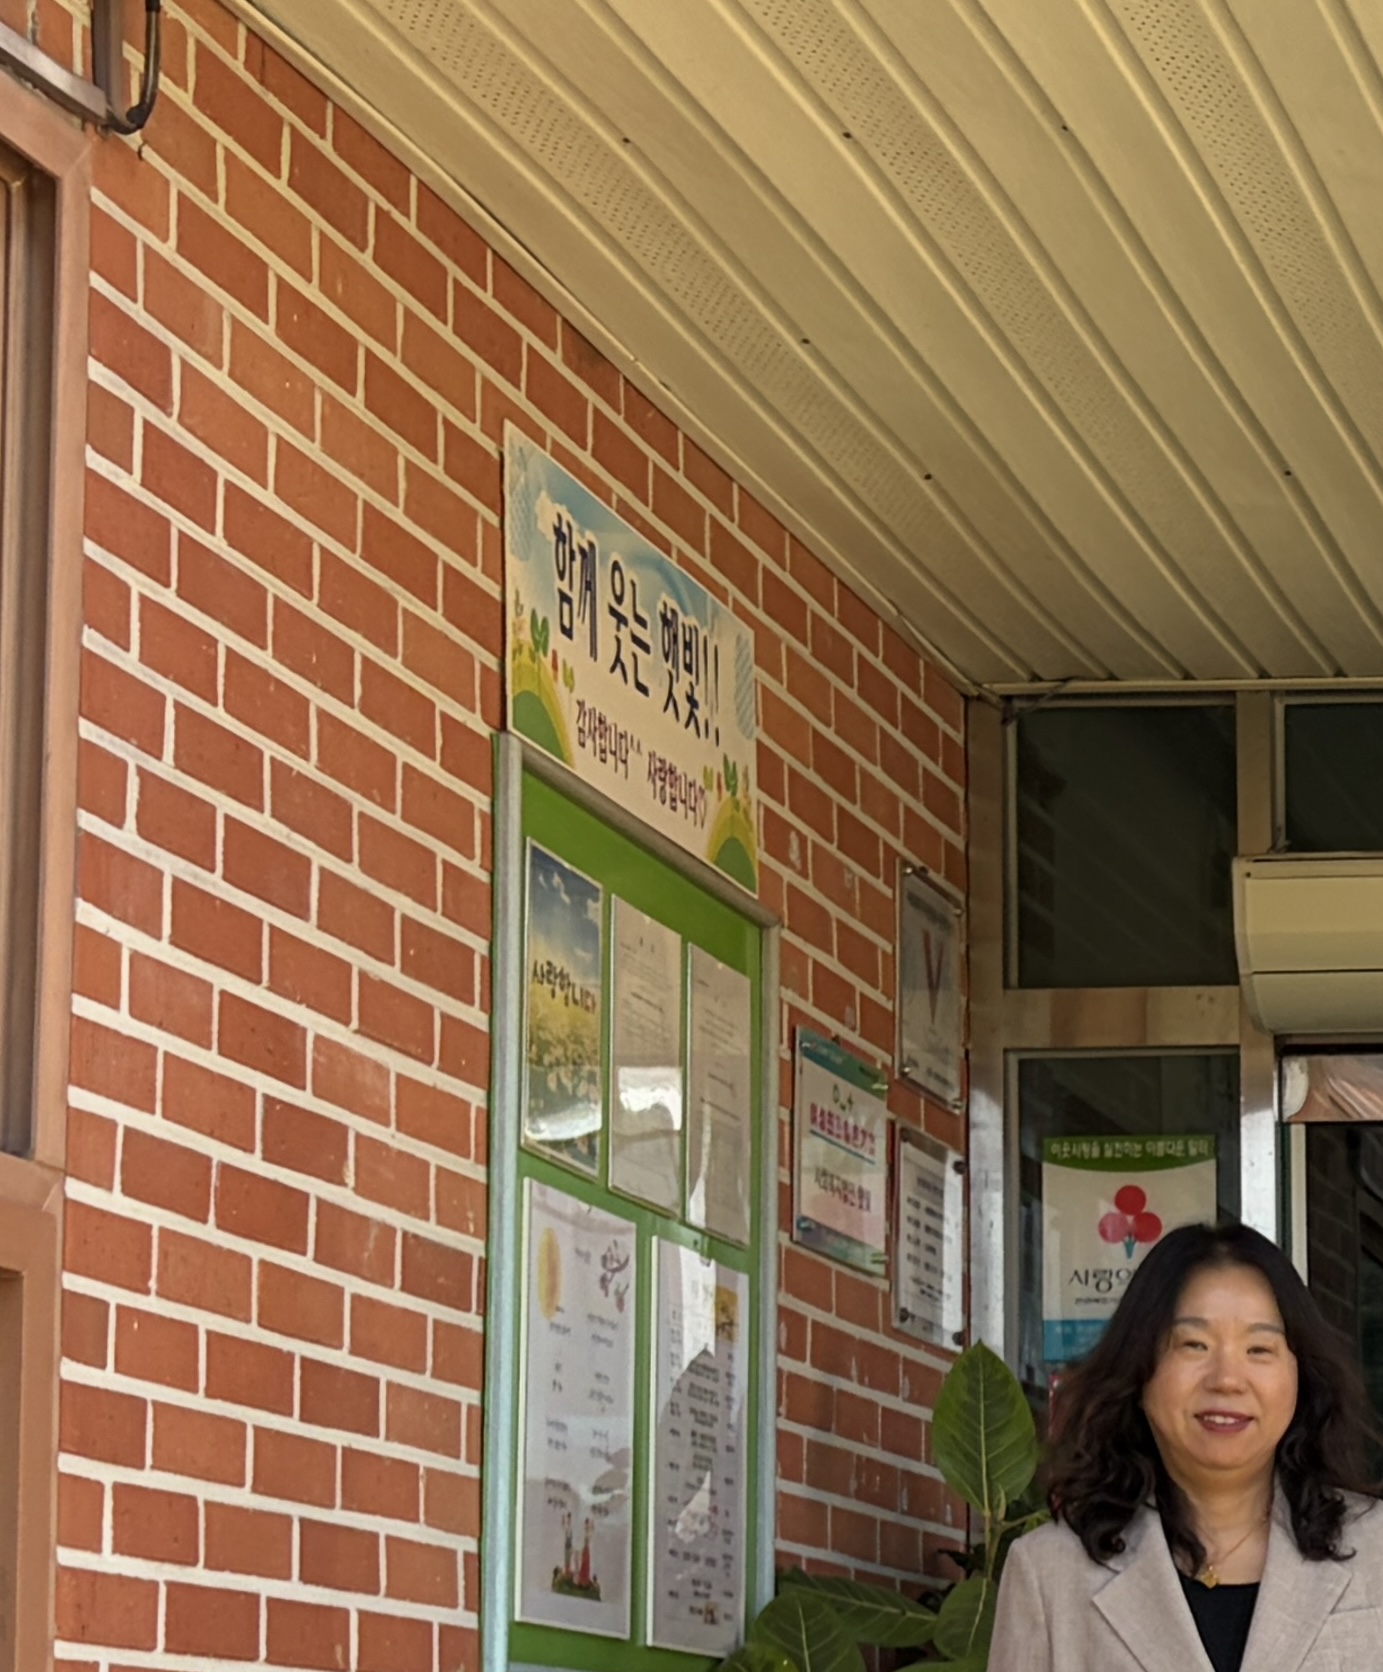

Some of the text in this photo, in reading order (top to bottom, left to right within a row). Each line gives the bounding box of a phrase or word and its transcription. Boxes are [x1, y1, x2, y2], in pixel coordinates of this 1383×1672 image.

[553, 511, 720, 748] 함께 웃는 햇빛!!
